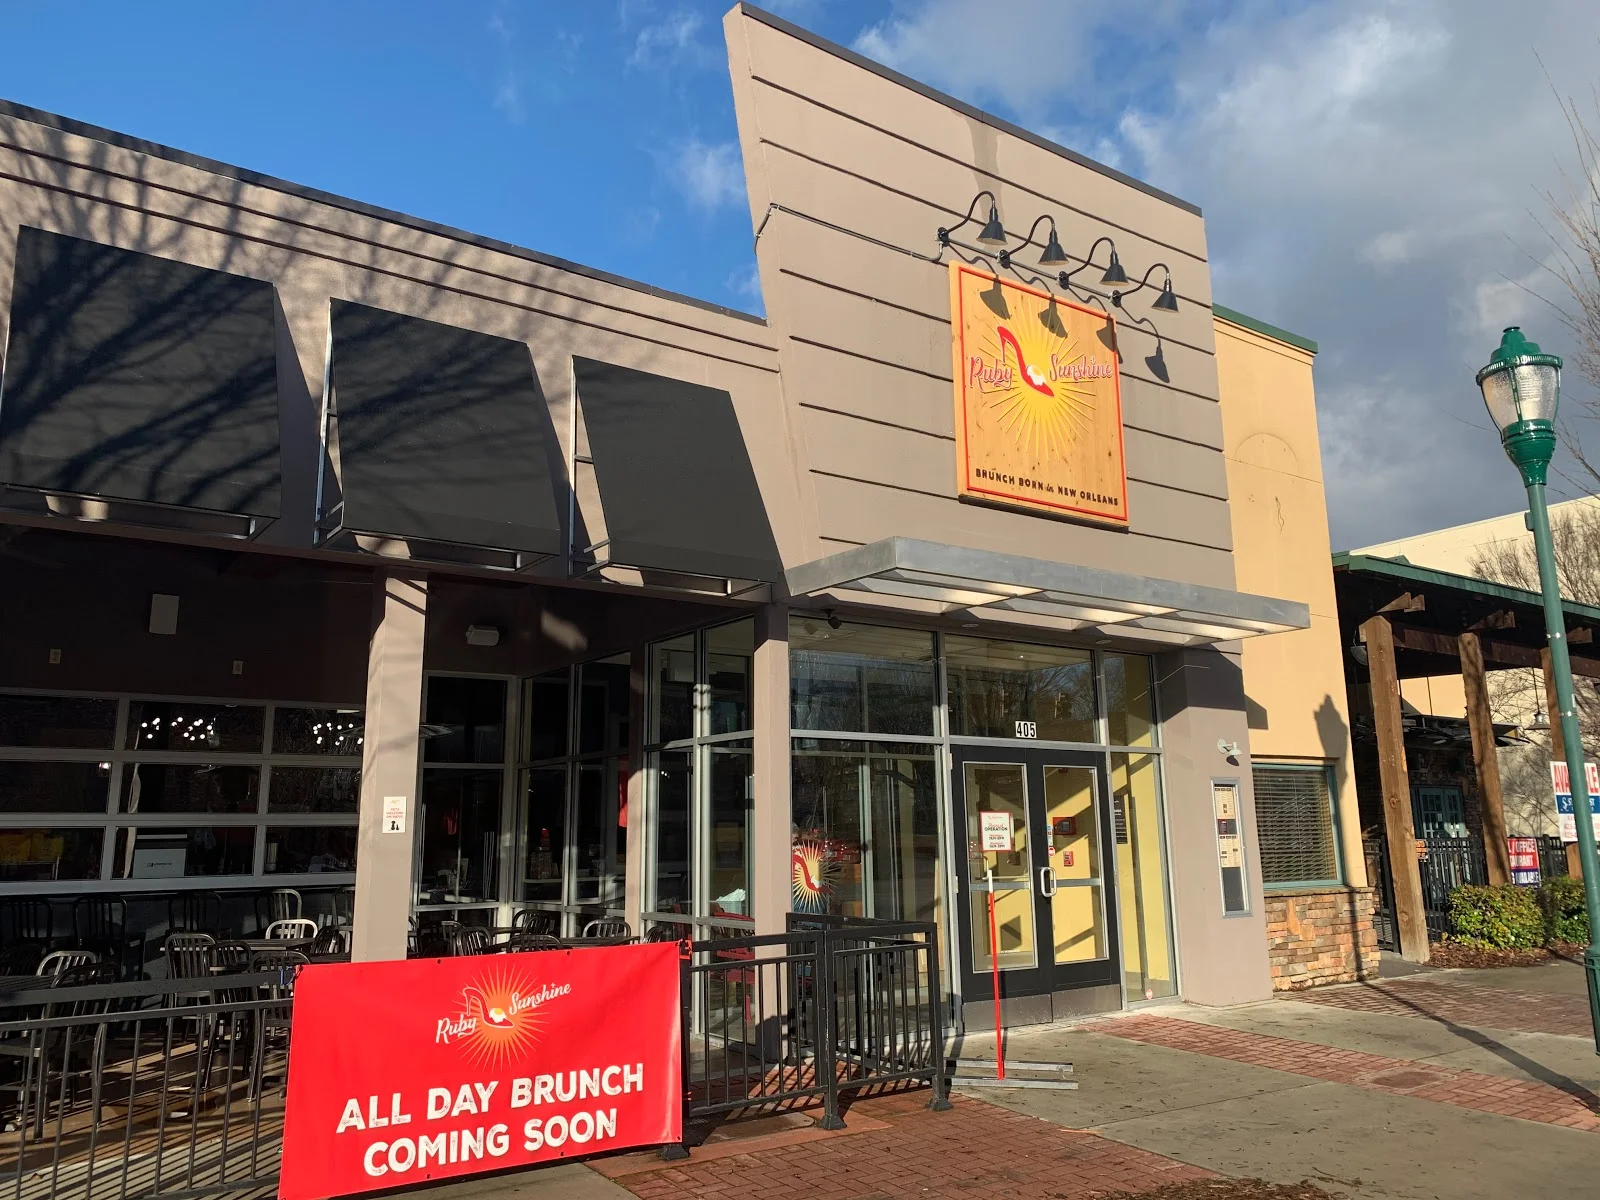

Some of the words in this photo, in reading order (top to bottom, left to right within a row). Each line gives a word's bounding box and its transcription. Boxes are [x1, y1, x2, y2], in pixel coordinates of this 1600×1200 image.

[968, 356, 1014, 393] Ruby
[1048, 353, 1113, 382] Sunshine
[975, 468, 1016, 485] BRUNCH
[1018, 477, 1044, 492] BORN
[1057, 485, 1077, 498] NEW
[1079, 490, 1119, 507] ORLEANS
[1016, 722, 1036, 738] 405
[1553, 765, 1599, 794] AVALE
[435, 1014, 477, 1044] Ruby
[508, 982, 572, 1016] Sunshine
[335, 1092, 412, 1134] ALL
[426, 1080, 500, 1121] DAY
[510, 1062, 644, 1109] BRUNCH
[363, 1123, 510, 1177] COMING
[523, 1108, 618, 1152] SOON
